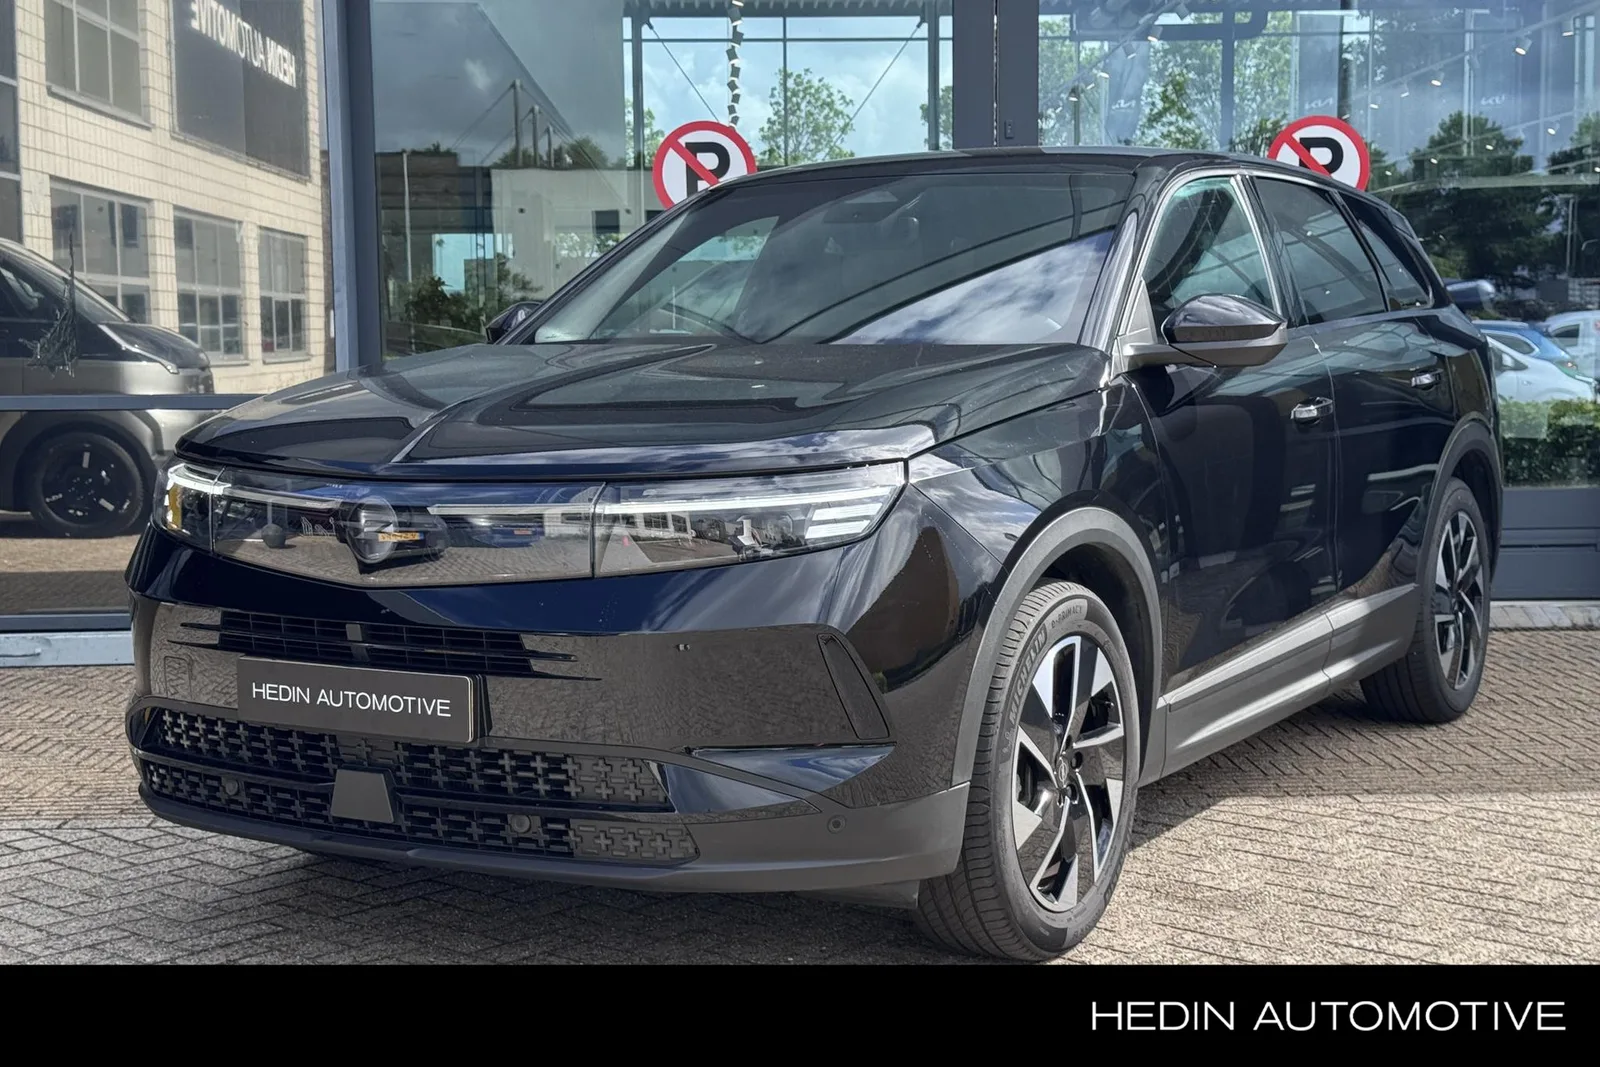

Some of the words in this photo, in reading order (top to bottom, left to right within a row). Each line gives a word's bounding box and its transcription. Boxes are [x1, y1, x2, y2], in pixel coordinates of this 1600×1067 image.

[685, 142, 730, 198] P
[1299, 137, 1343, 174] P
[252, 682, 310, 704] HEDIN
[316, 689, 452, 717] AUTOMOTIVE
[1009, 629, 1046, 725] MICHELIN
